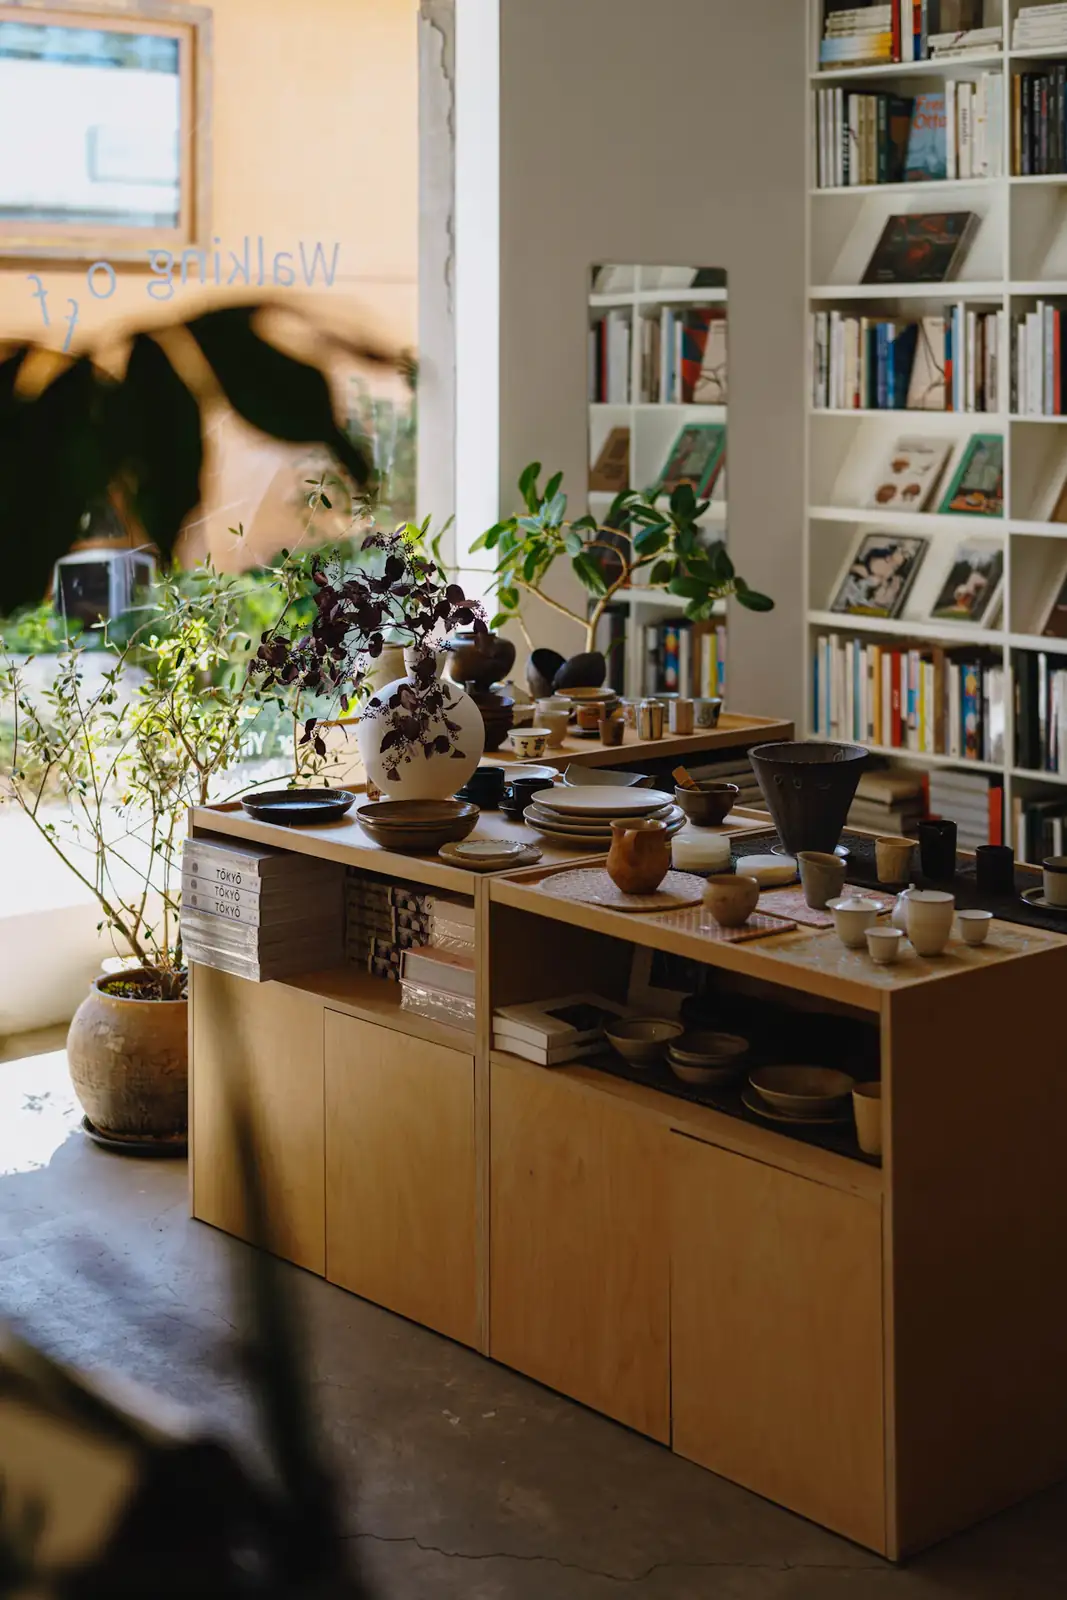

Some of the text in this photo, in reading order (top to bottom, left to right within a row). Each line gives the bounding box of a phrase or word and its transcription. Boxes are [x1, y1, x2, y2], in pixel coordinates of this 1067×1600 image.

[216, 868, 242, 884] TŌKYŌ
[215, 885, 240, 902] TŌKYŌ
[215, 901, 240, 918] TŌKYŌ
